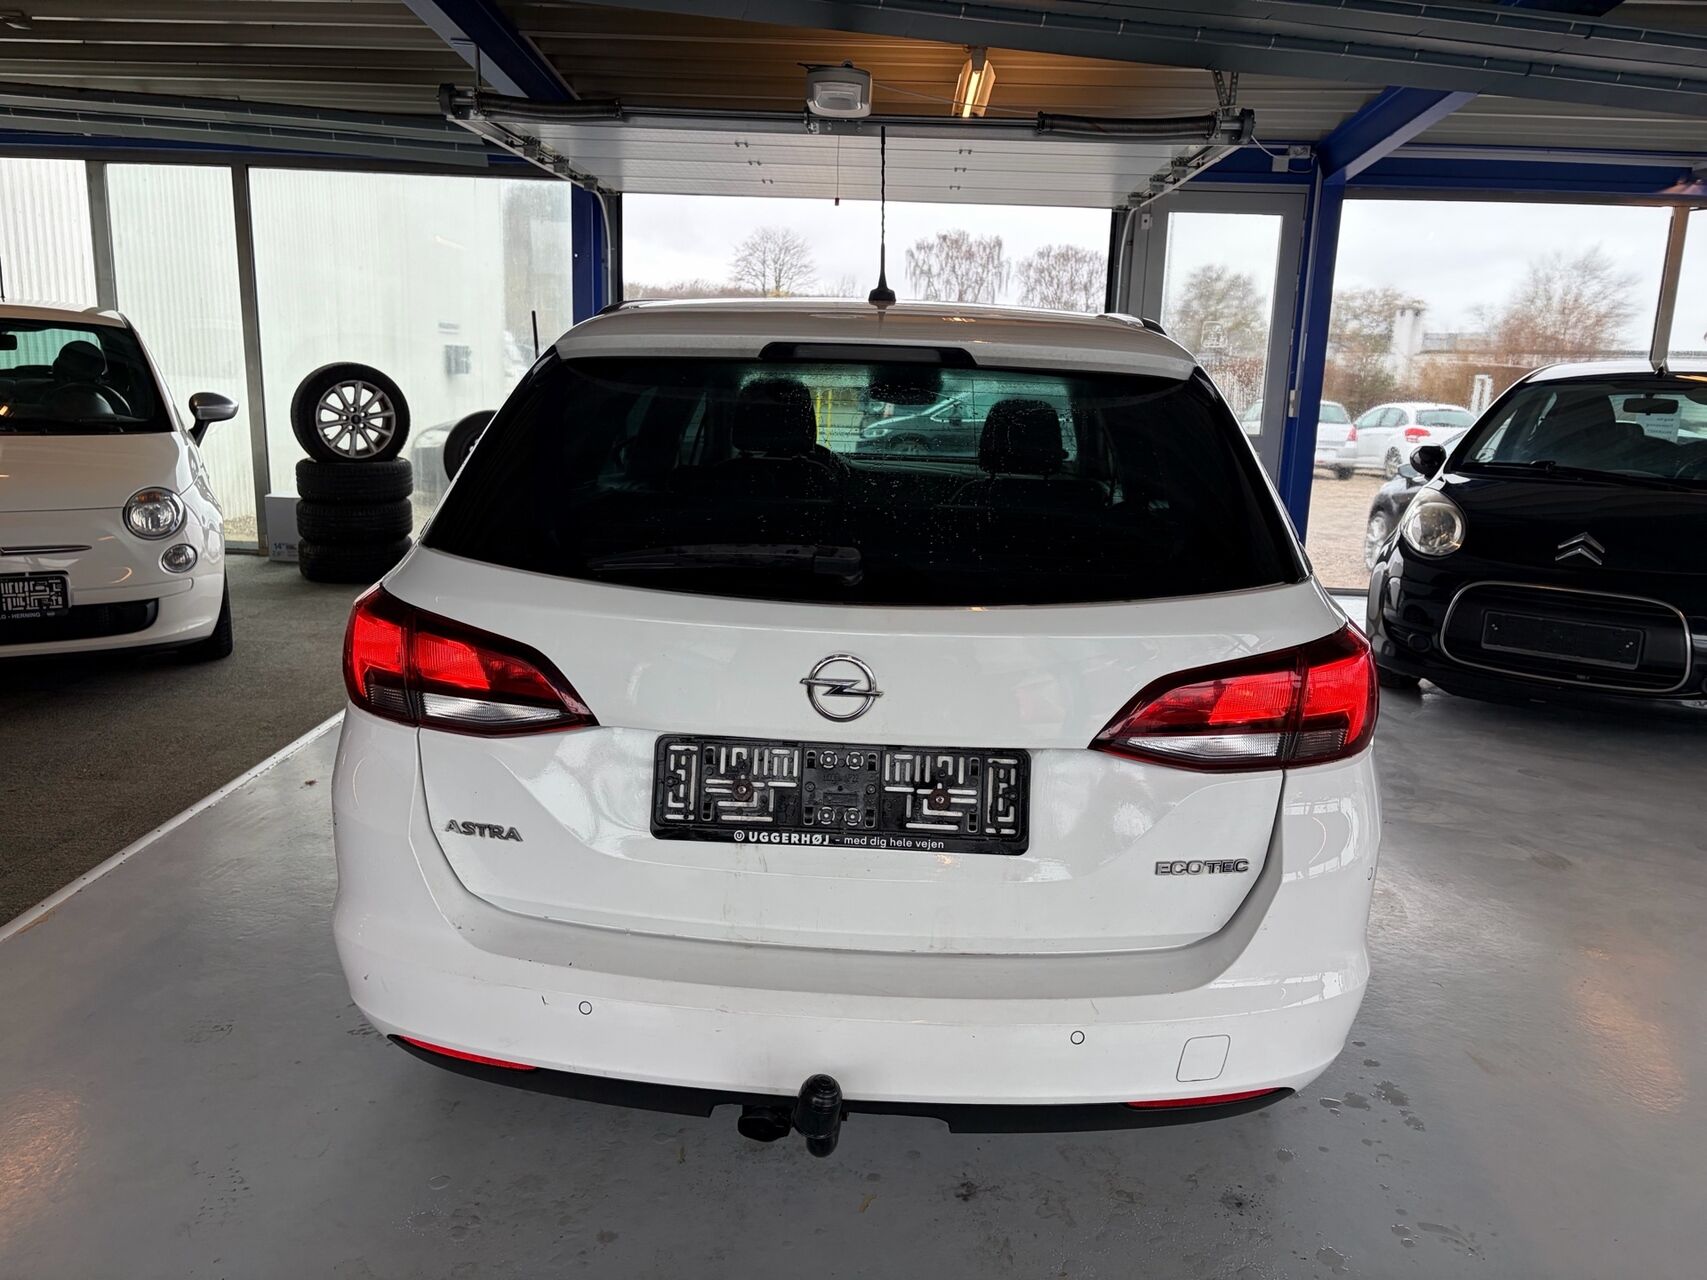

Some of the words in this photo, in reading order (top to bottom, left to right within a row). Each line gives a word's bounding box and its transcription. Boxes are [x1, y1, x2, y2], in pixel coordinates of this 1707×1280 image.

[445, 819, 523, 841] ASTRA
[748, 831, 830, 845] UGGERHØJ
[844, 836, 867, 845] med
[870, 837, 887, 848] dig
[890, 837, 912, 847] hele
[915, 839, 944, 850] vejen
[1155, 859, 1249, 875] ECOTEC
